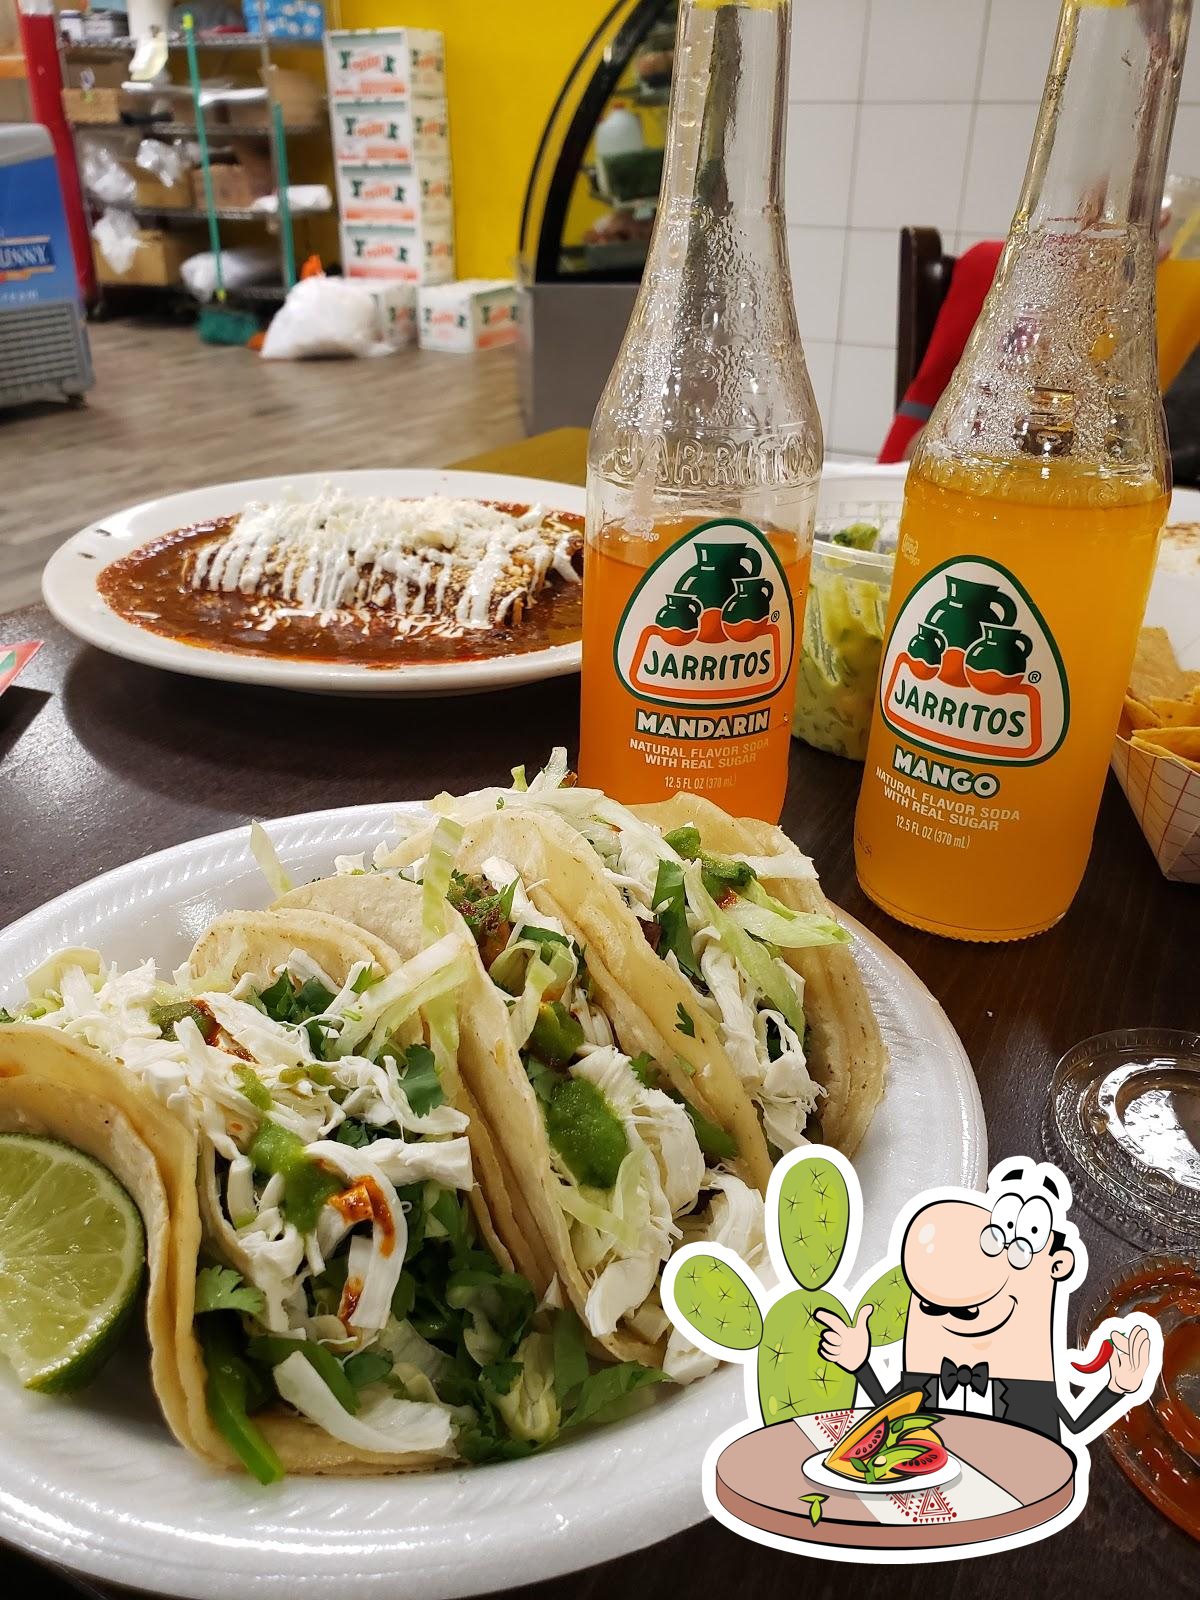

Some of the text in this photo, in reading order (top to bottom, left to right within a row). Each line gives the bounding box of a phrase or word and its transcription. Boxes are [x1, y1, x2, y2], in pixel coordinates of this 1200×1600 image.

[644, 650, 771, 681] JARRITOS
[636, 708, 770, 739] MANDARIN
[895, 680, 1026, 737] JARRITOS
[630, 738, 769, 758] NATURAL FLAVOR SODA
[645, 752, 757, 769] WITH REAL SUGAR
[664, 775, 681, 789] 12.5
[682, 779, 692, 789] FL
[694, 778, 704, 790] OZ
[893, 745, 1000, 798] MANGO
[876, 766, 1020, 821] NATURAL FLAVOR SODA
[884, 785, 1000, 831] WITH REAL SUGAR
[896, 814, 971, 849] 12.5 FL OZ (370 mL)
